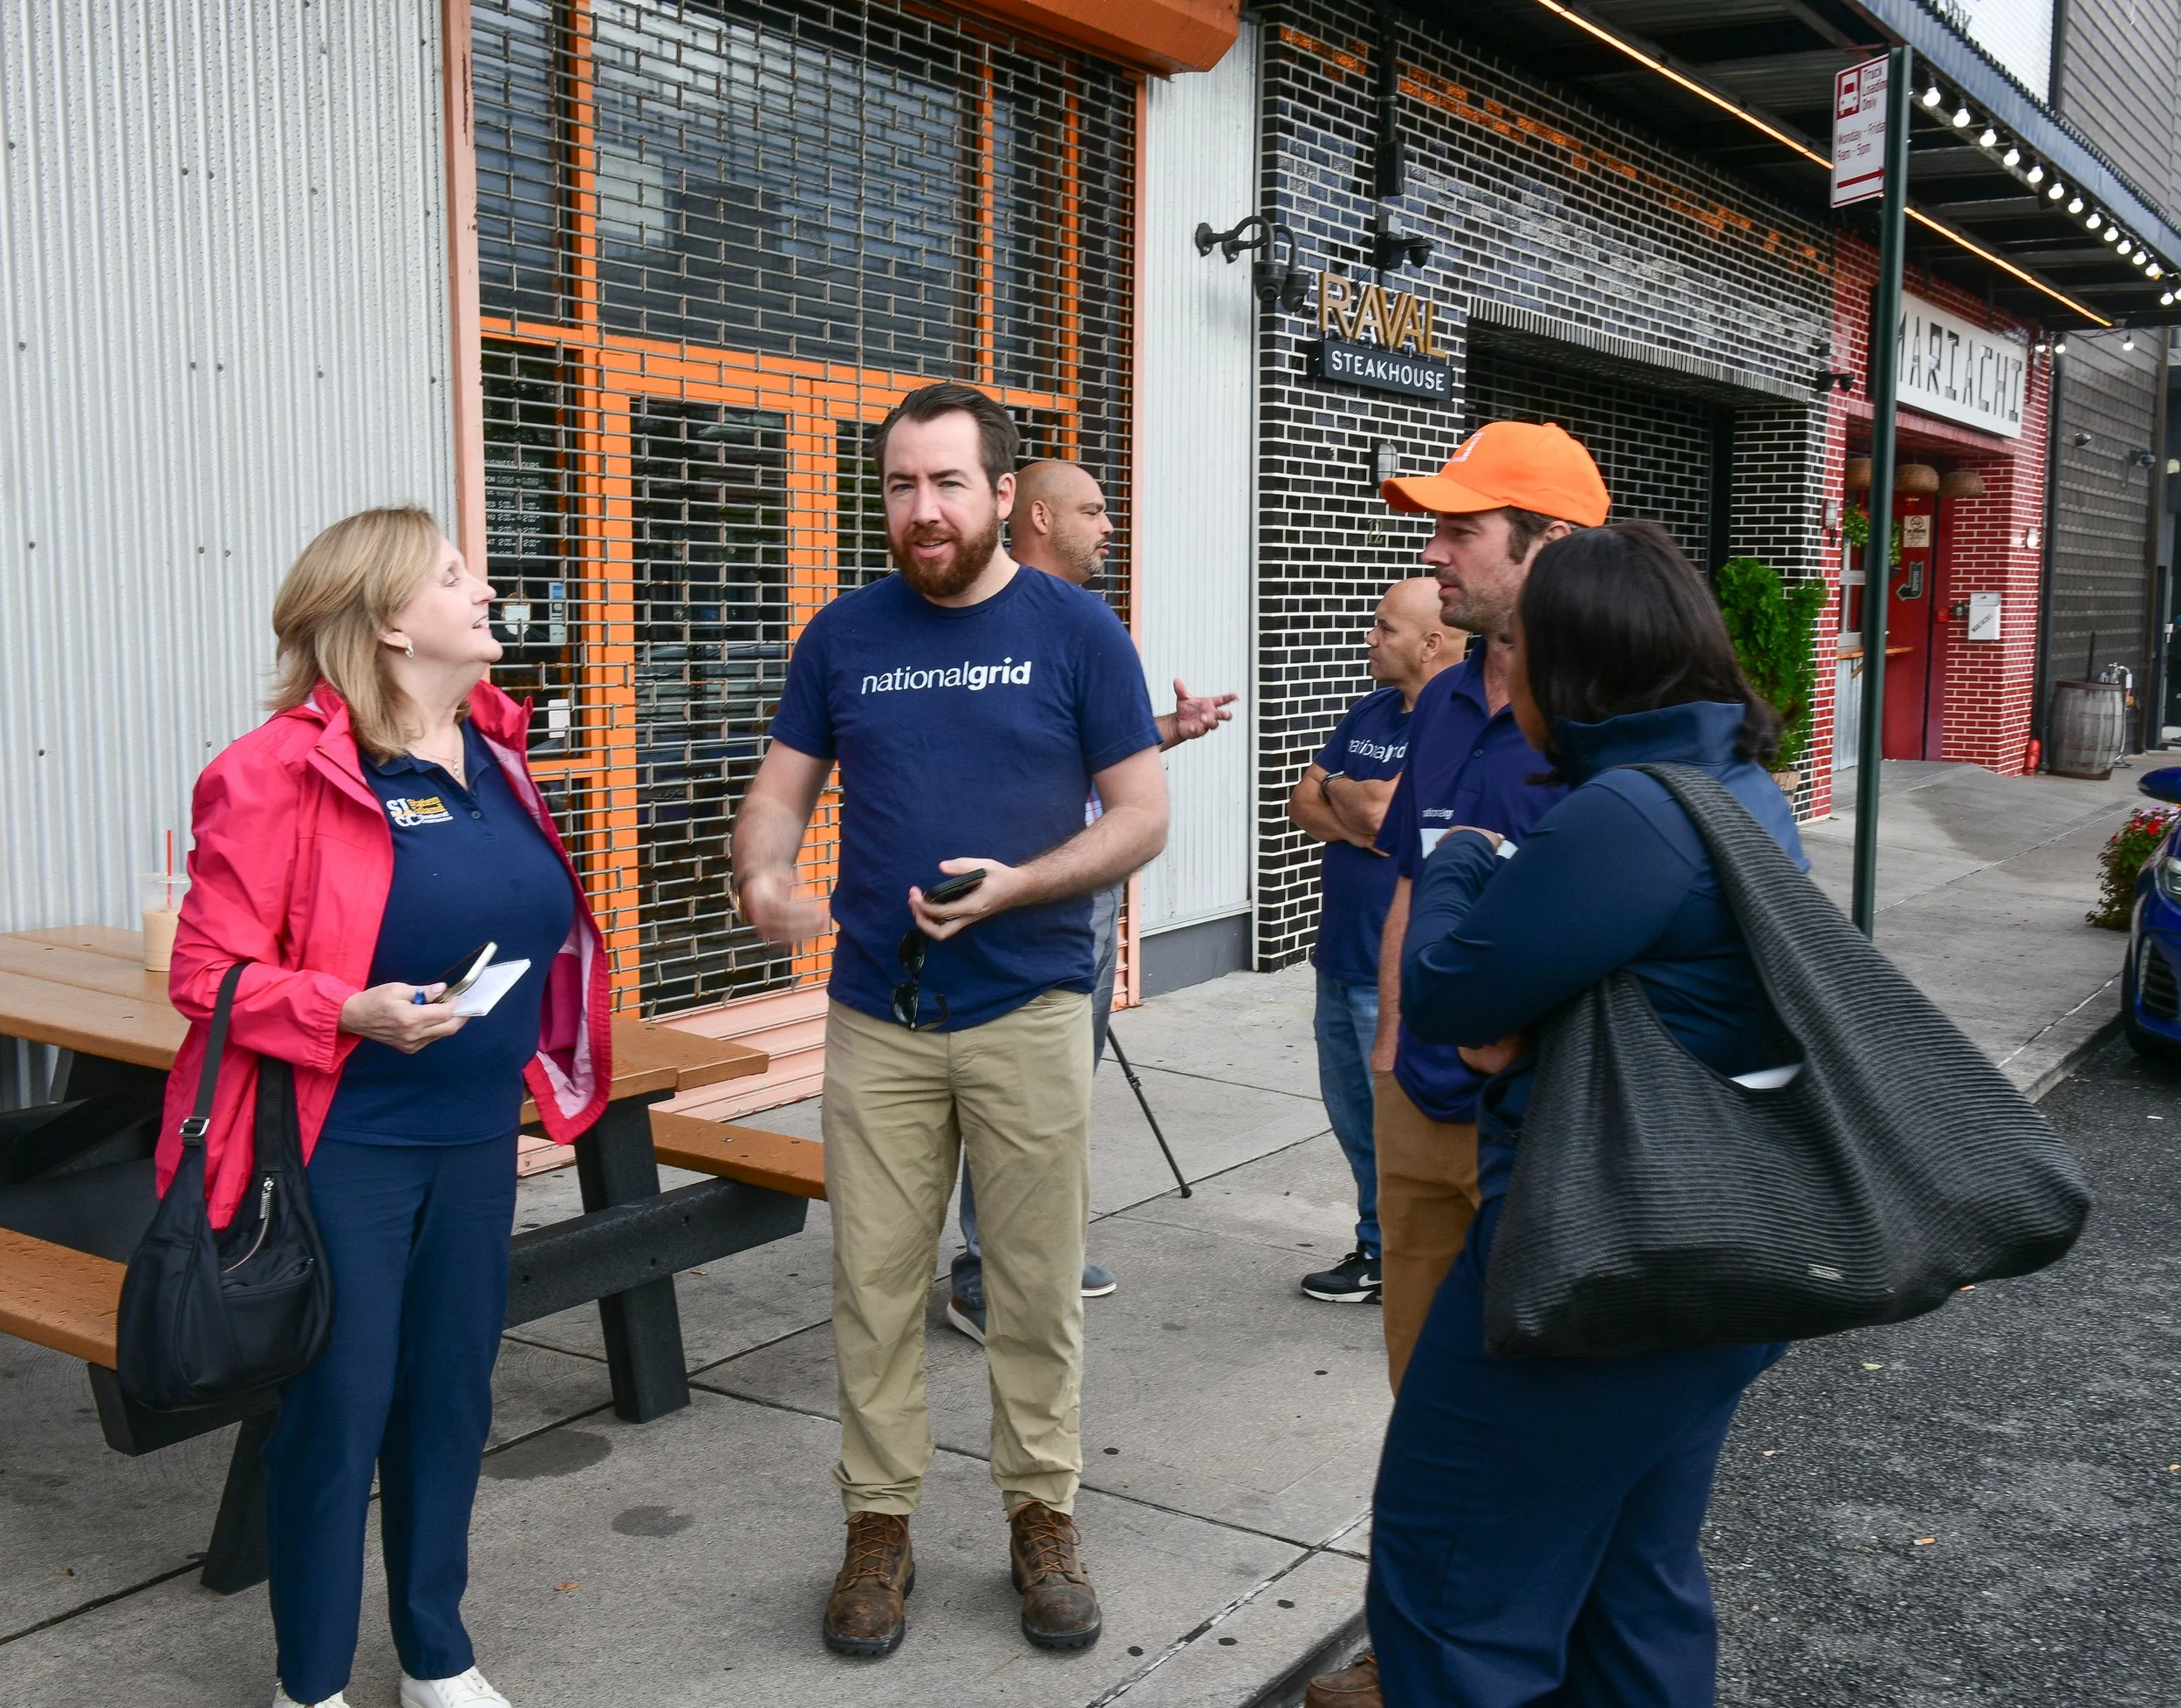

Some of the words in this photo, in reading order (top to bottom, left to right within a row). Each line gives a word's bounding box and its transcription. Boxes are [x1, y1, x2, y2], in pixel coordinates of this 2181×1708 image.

[1863, 79, 1889, 97] Loadin
[1868, 121, 1885, 136] Frida
[1318, 271, 1447, 359] RAVAL
[1331, 350, 1445, 392] STEAKHOUSE
[860, 656, 1032, 694] nationalgrid
